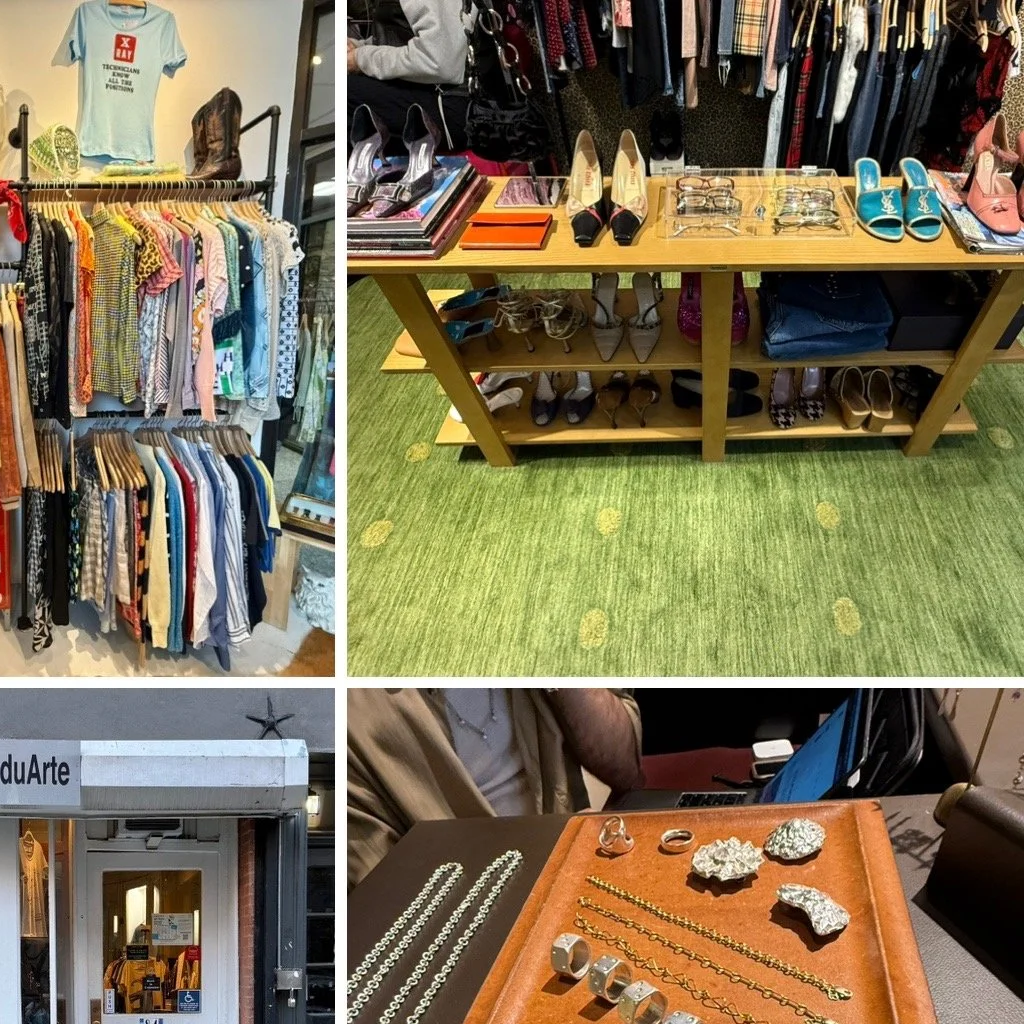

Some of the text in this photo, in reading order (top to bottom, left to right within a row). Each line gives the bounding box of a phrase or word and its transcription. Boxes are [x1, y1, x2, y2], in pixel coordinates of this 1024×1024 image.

[120, 37, 132, 48] X
[116, 48, 133, 61] RAY
[102, 63, 140, 75] TECHNICIANS
[112, 71, 130, 79] KNOW
[0, 753, 70, 786] duArte
